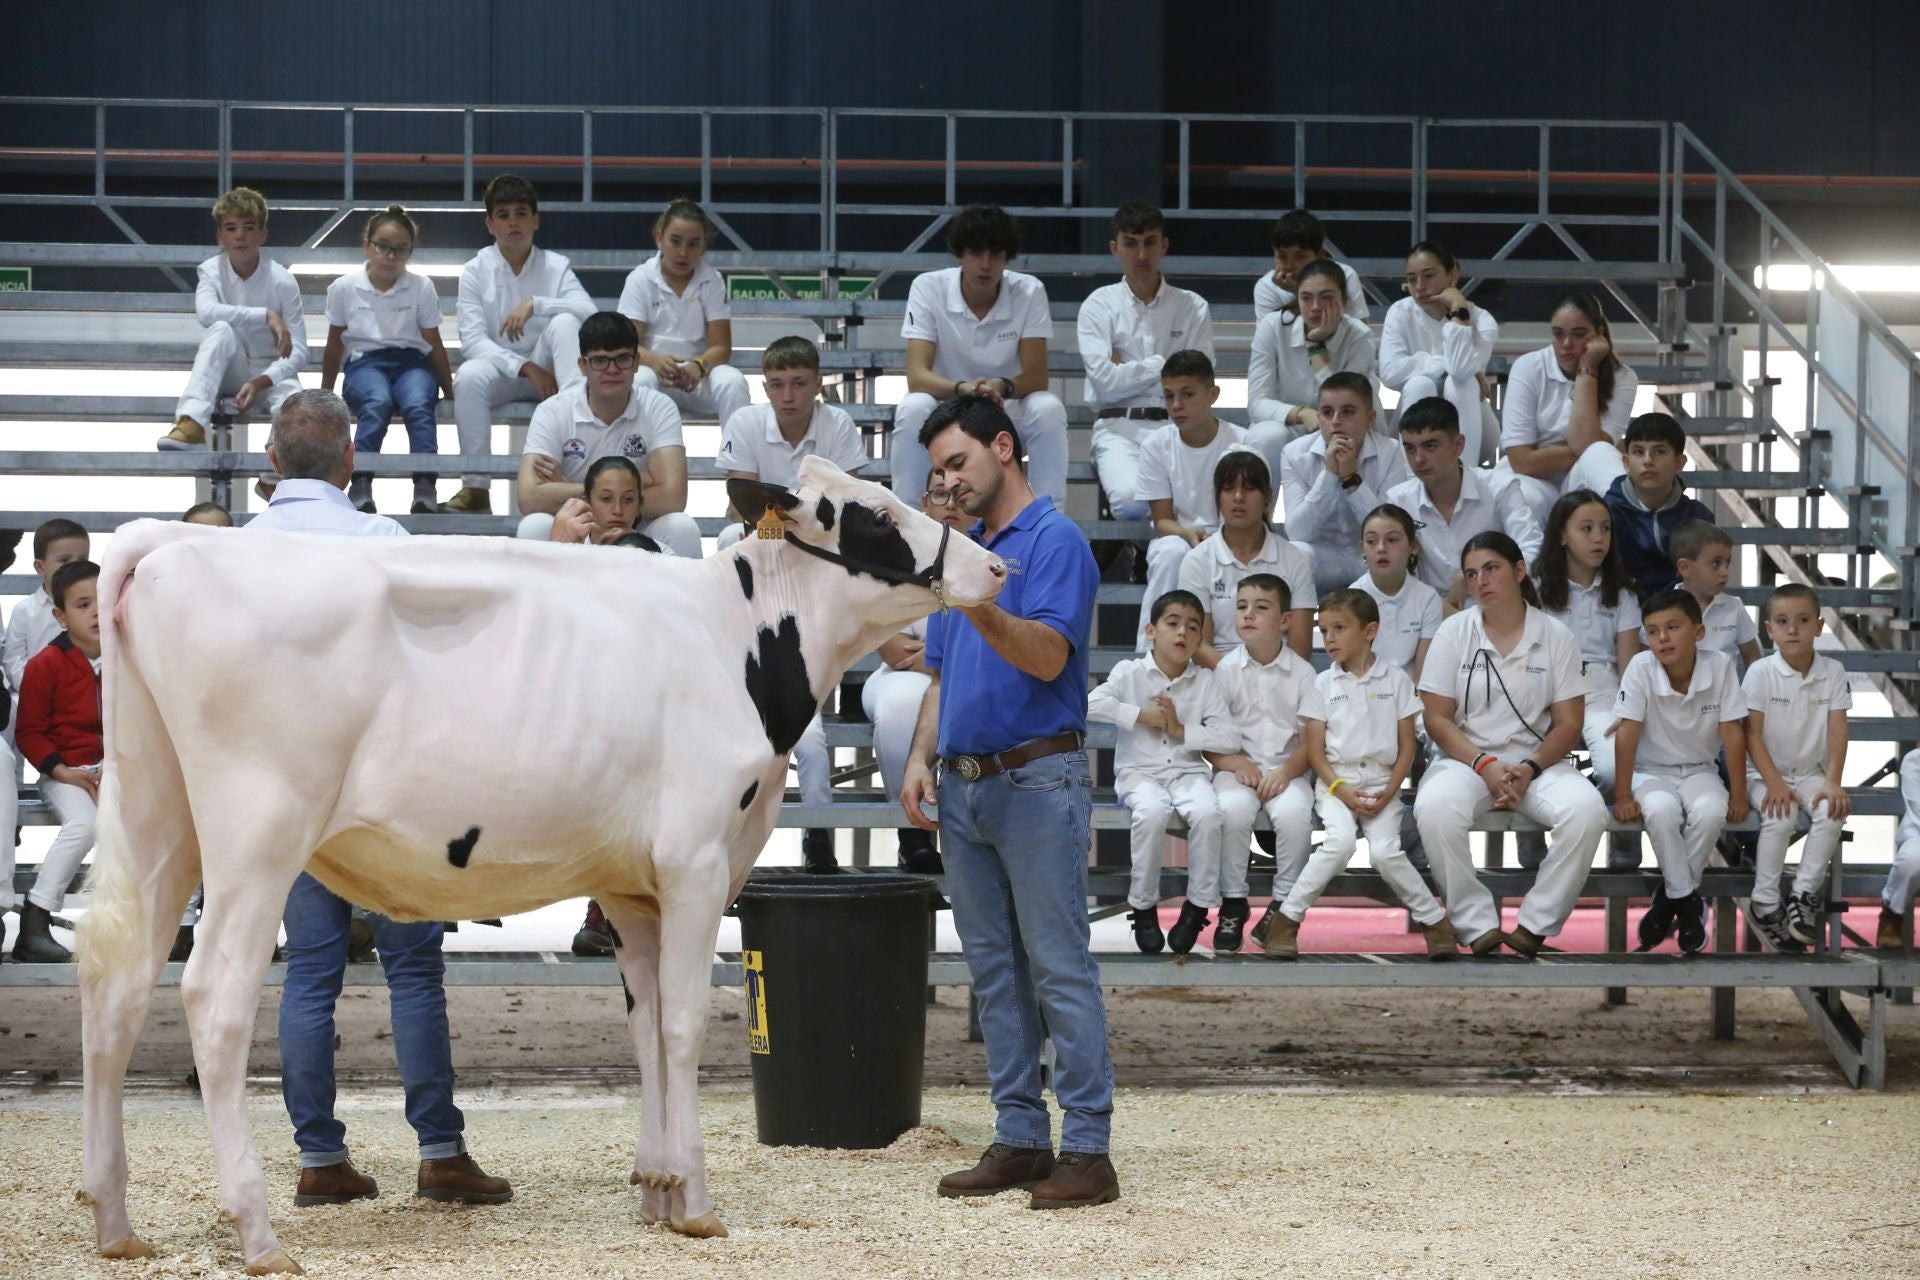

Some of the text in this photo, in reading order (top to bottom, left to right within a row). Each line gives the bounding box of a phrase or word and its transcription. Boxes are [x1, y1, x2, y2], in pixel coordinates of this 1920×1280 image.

[732, 289, 775, 300] SALIDA
[796, 290, 873, 301] EMEENC
[758, 528, 782, 539] 0688
